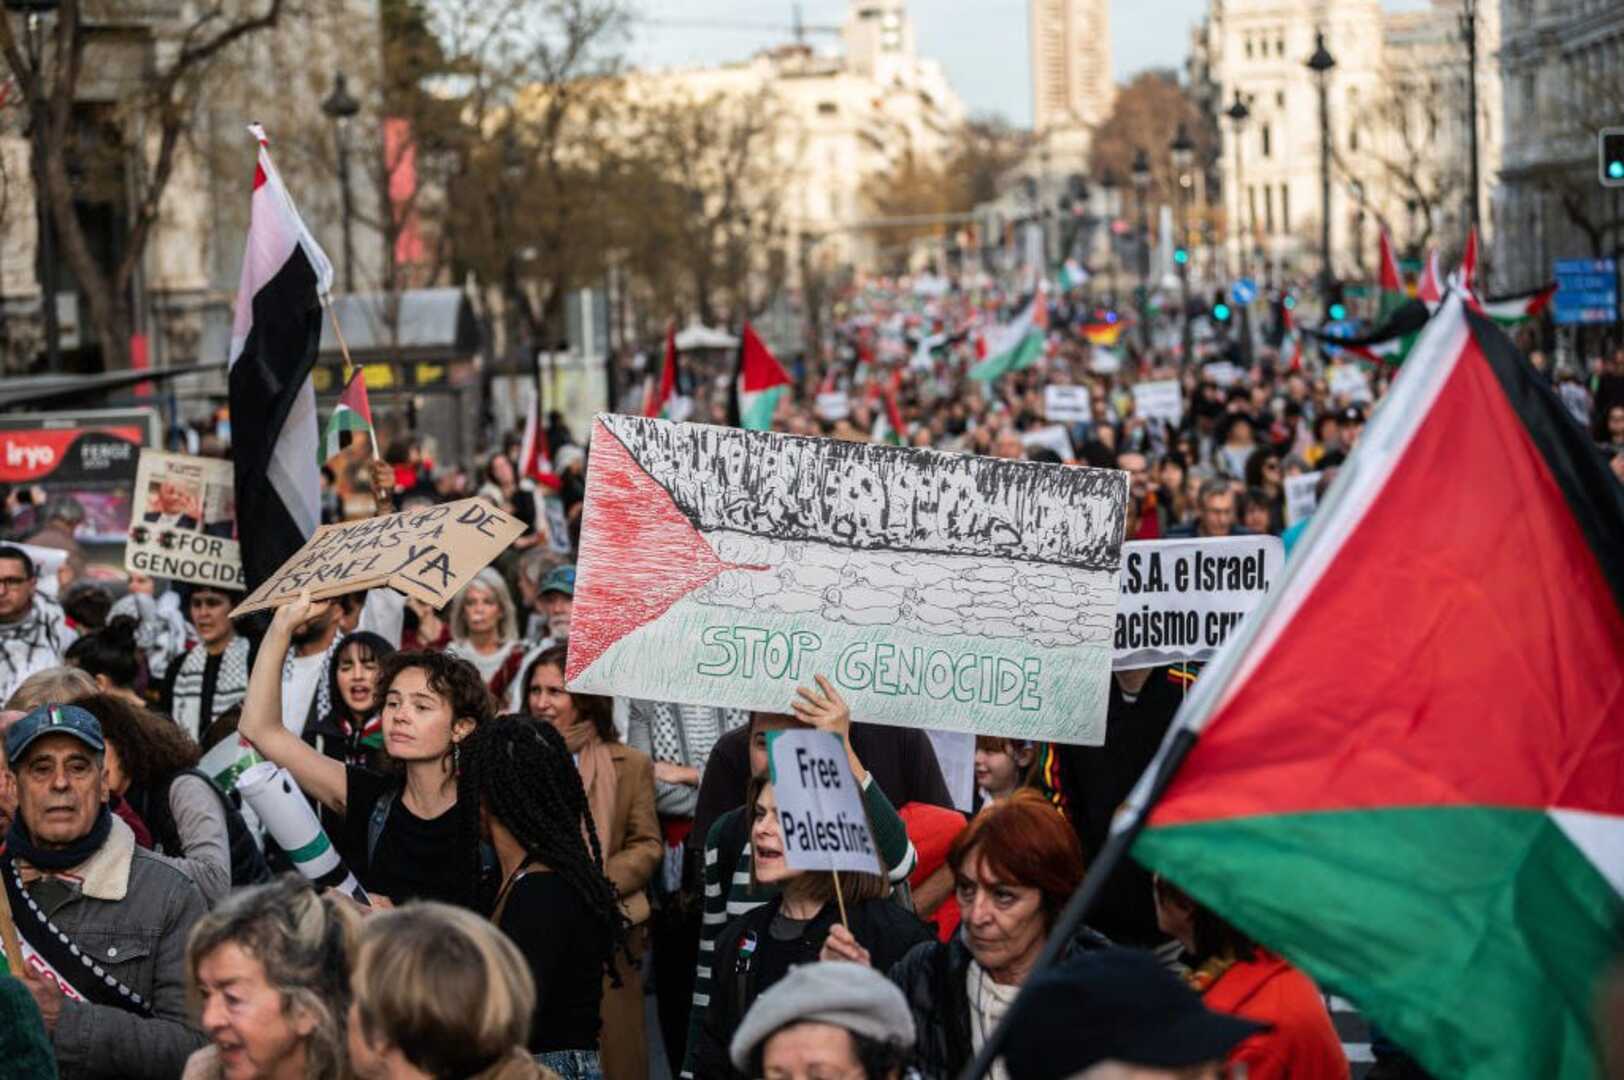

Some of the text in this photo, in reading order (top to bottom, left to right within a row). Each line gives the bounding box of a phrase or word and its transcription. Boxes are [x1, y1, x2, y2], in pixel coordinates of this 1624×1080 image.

[456, 503, 508, 538] DE
[132, 551, 245, 584] GENOCIDE
[179, 533, 223, 558] FOR
[257, 545, 457, 601] ISRAEL YA
[1120, 549, 1270, 594] .S.A. e Israel,
[1114, 604, 1200, 650] acismo
[697, 626, 1042, 711] STOP GENOCIDE
[796, 748, 841, 789] Free
[781, 810, 872, 855] Palestine
